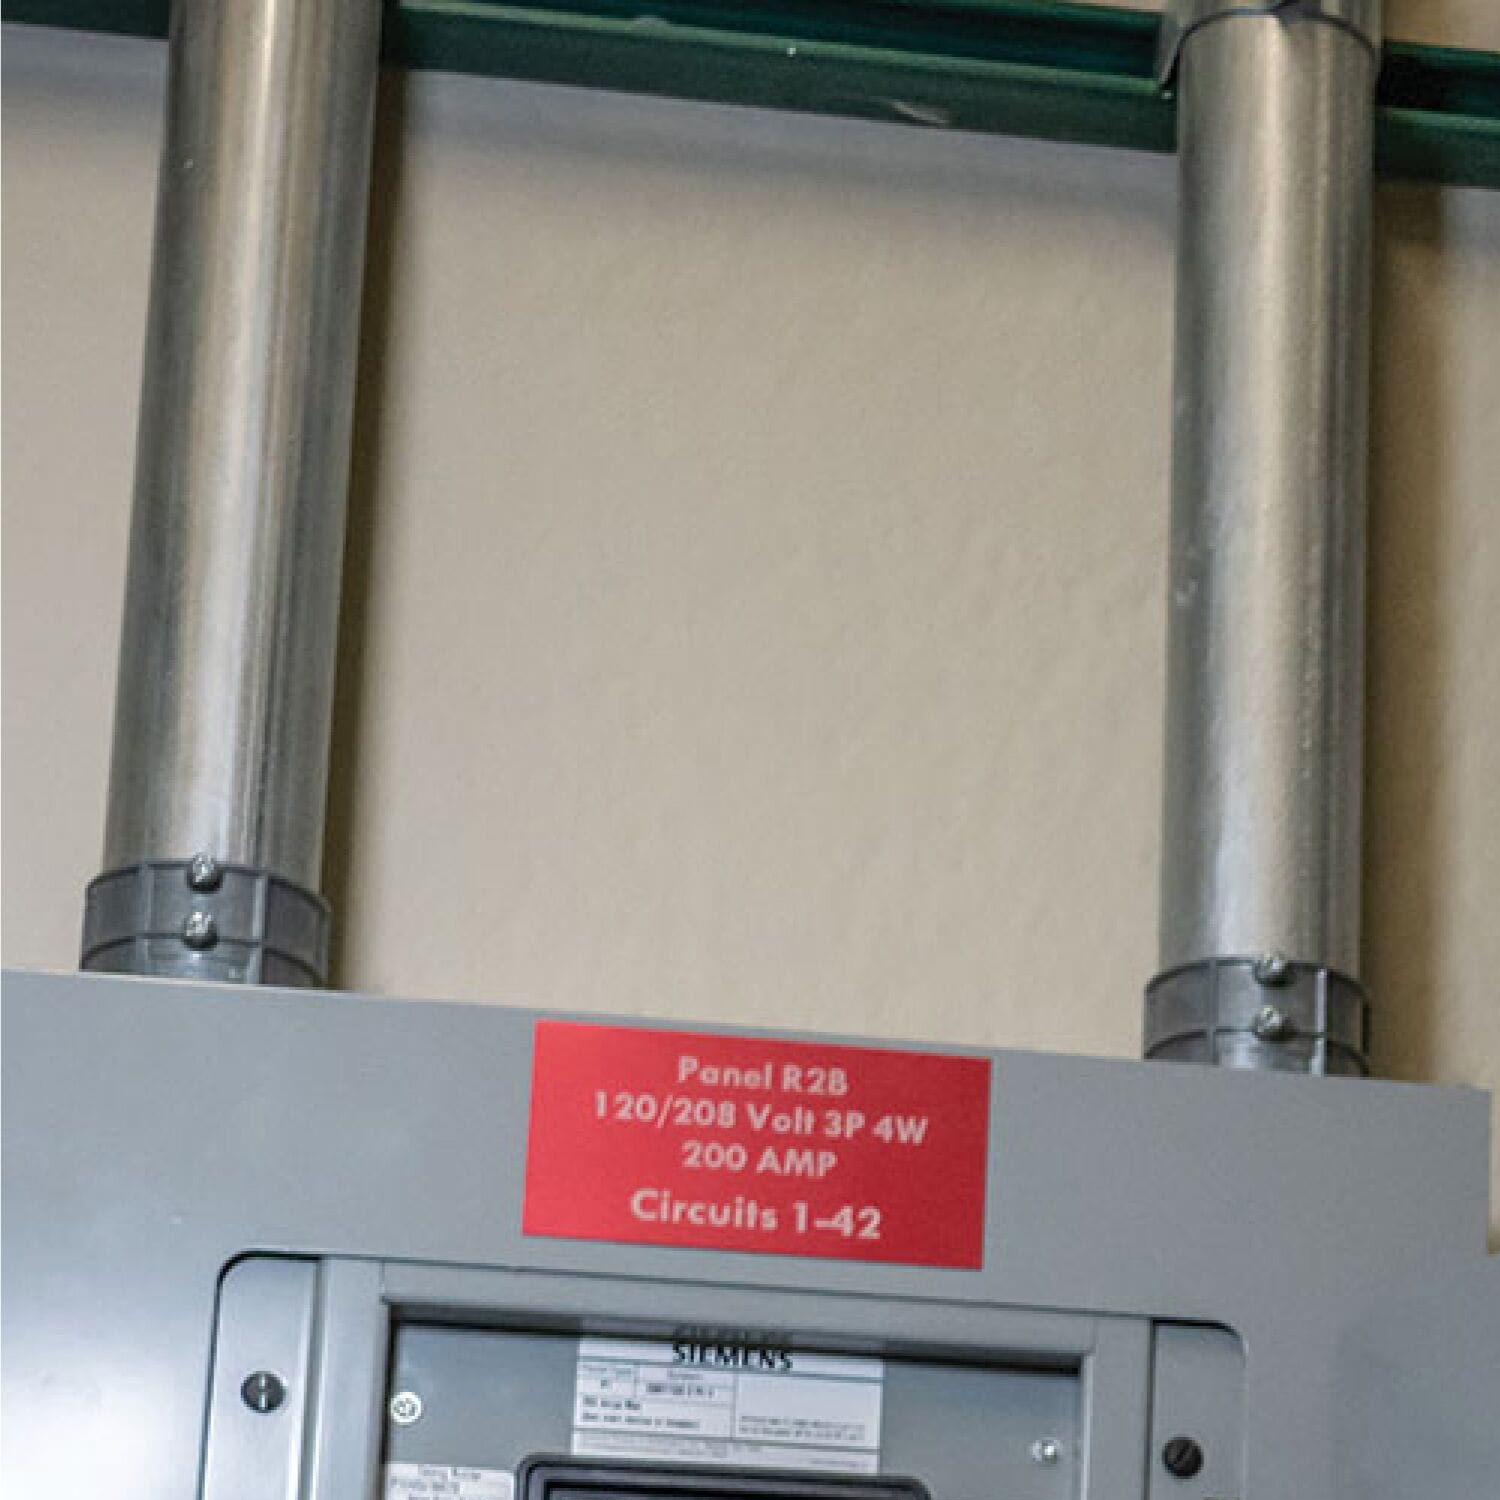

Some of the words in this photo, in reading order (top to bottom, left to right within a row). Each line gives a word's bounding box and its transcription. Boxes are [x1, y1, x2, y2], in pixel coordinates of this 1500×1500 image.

[678, 1055, 773, 1091] Panel
[781, 1063, 849, 1096] R2B
[594, 1089, 738, 1130] 120/208
[747, 1103, 816, 1136] Volt
[823, 1109, 867, 1138] 3P
[871, 1113, 930, 1146] 4W
[680, 1140, 750, 1171] 200
[755, 1146, 839, 1177] AMP
[629, 1188, 780, 1232] Circuits
[792, 1201, 882, 1240] 1-42
[672, 1341, 794, 1371] SIEMENS
